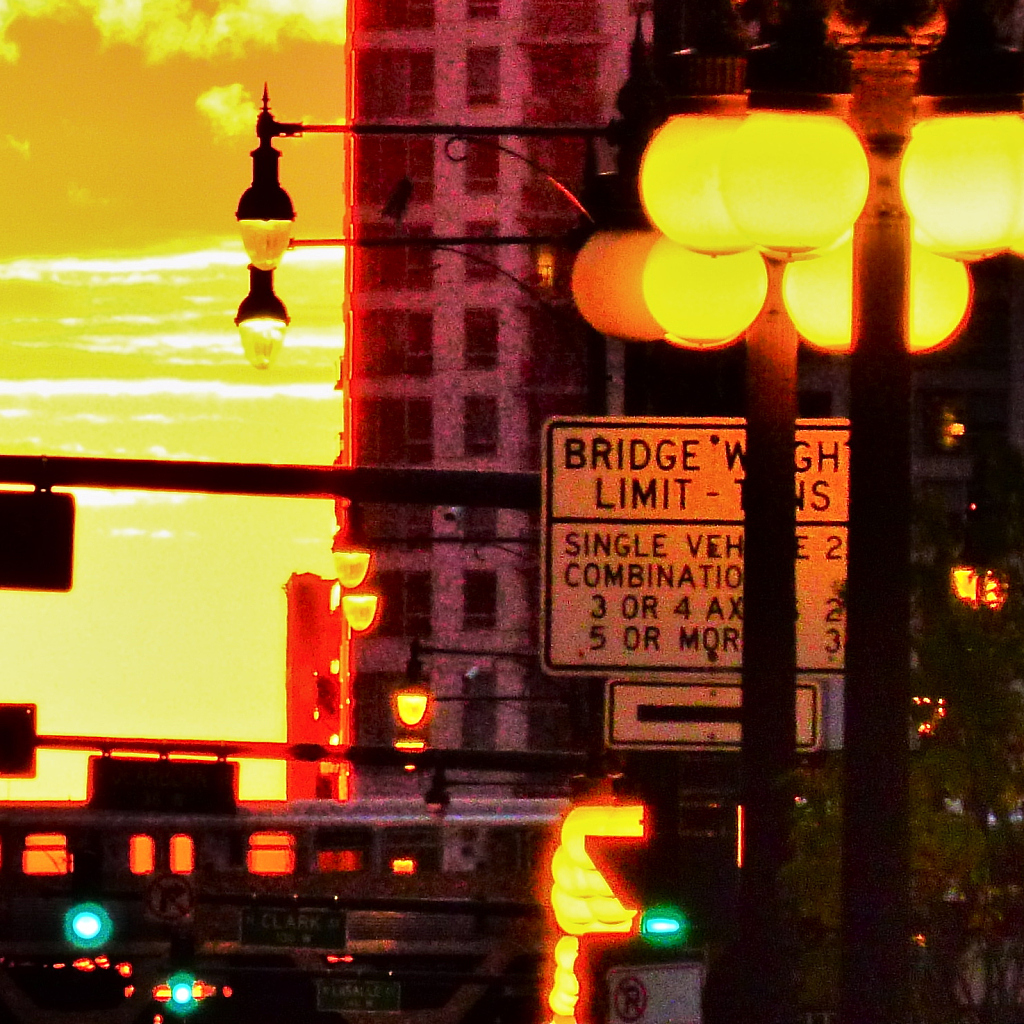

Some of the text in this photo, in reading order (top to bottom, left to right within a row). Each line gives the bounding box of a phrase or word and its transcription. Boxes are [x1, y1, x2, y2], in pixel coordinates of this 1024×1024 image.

[565, 438, 850, 473] BRIDGE WGH
[596, 478, 692, 511] LIMIT
[565, 533, 667, 559] SINGLE
[687, 534, 809, 560] VEHE
[564, 562, 742, 589] COMBINATIO
[591, 595, 607, 619] 3
[622, 595, 658, 619] OR
[675, 595, 692, 620] 4
[589, 626, 607, 650] 5
[625, 626, 661, 651] OR
[679, 626, 740, 652] MOR
[261, 912, 322, 930] CLARK
